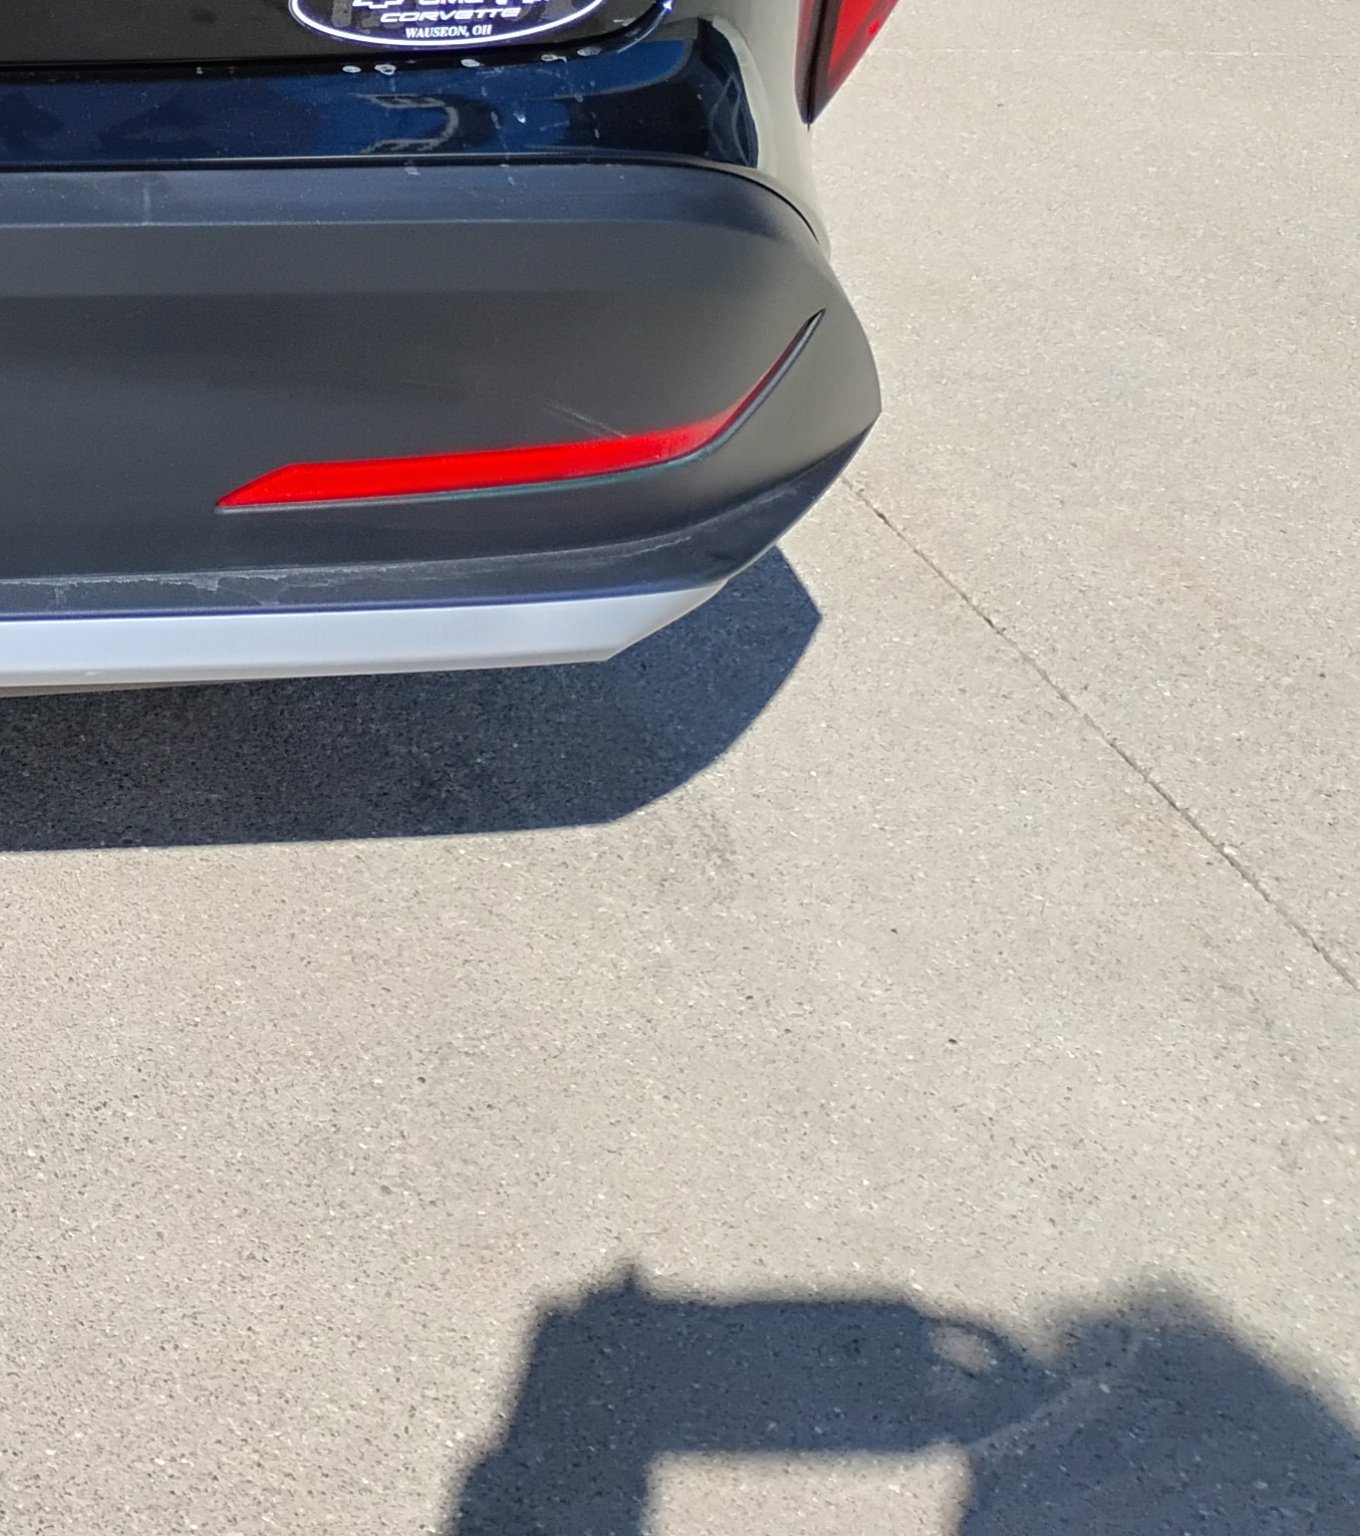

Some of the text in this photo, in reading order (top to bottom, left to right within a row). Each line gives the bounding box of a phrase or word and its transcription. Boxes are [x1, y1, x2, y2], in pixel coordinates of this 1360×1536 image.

[380, 7, 522, 23] CORVETTE
[405, 24, 492, 39] WAUSEON, OH
